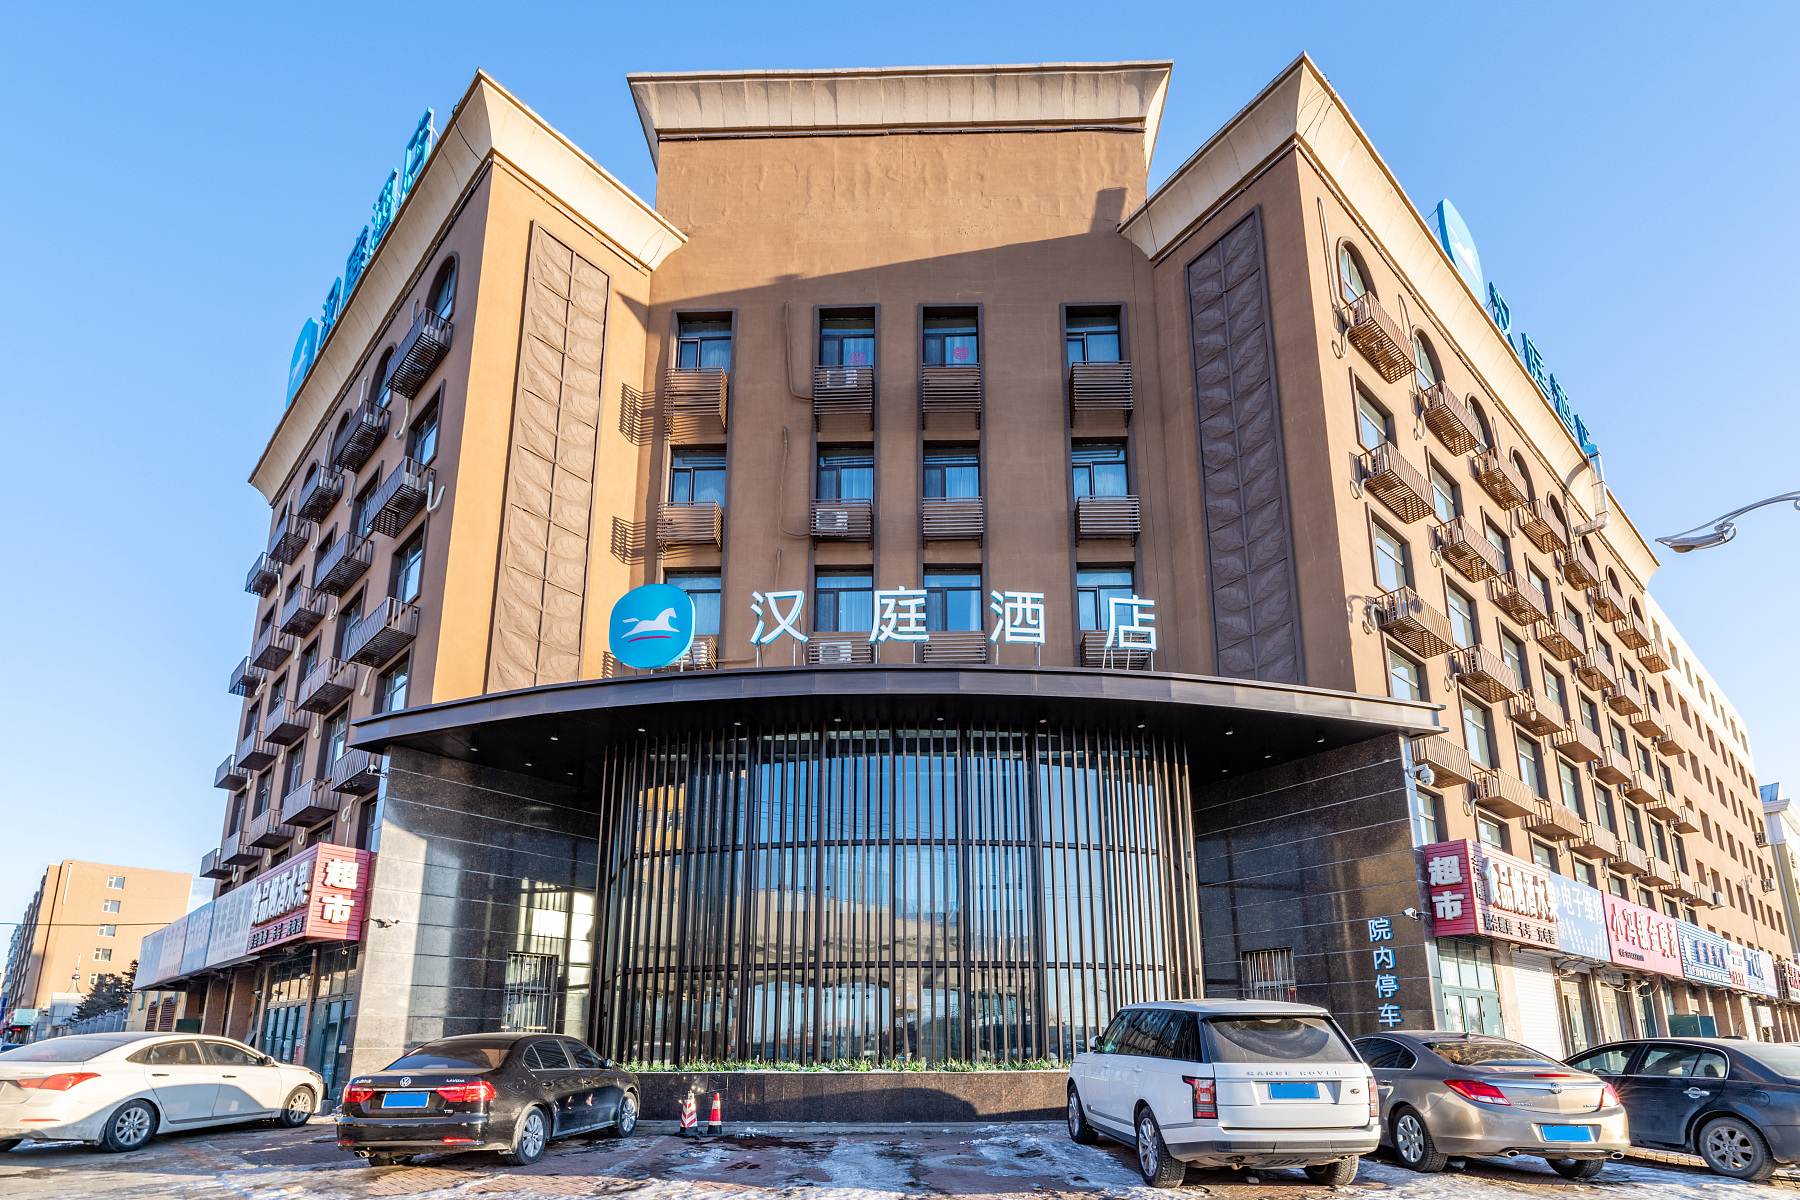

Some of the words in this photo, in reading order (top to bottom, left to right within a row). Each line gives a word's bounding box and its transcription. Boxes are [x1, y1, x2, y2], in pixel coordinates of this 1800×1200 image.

[749, 586, 1157, 651] 汉庭酒店
[252, 860, 315, 926] 食品烟酒水果
[322, 859, 359, 923] 超市
[1428, 856, 1464, 920] 超市
[1481, 857, 1559, 922] 食品烟酒水果
[1561, 882, 1604, 924] 电子维修
[1368, 918, 1404, 1027] 院内停车
